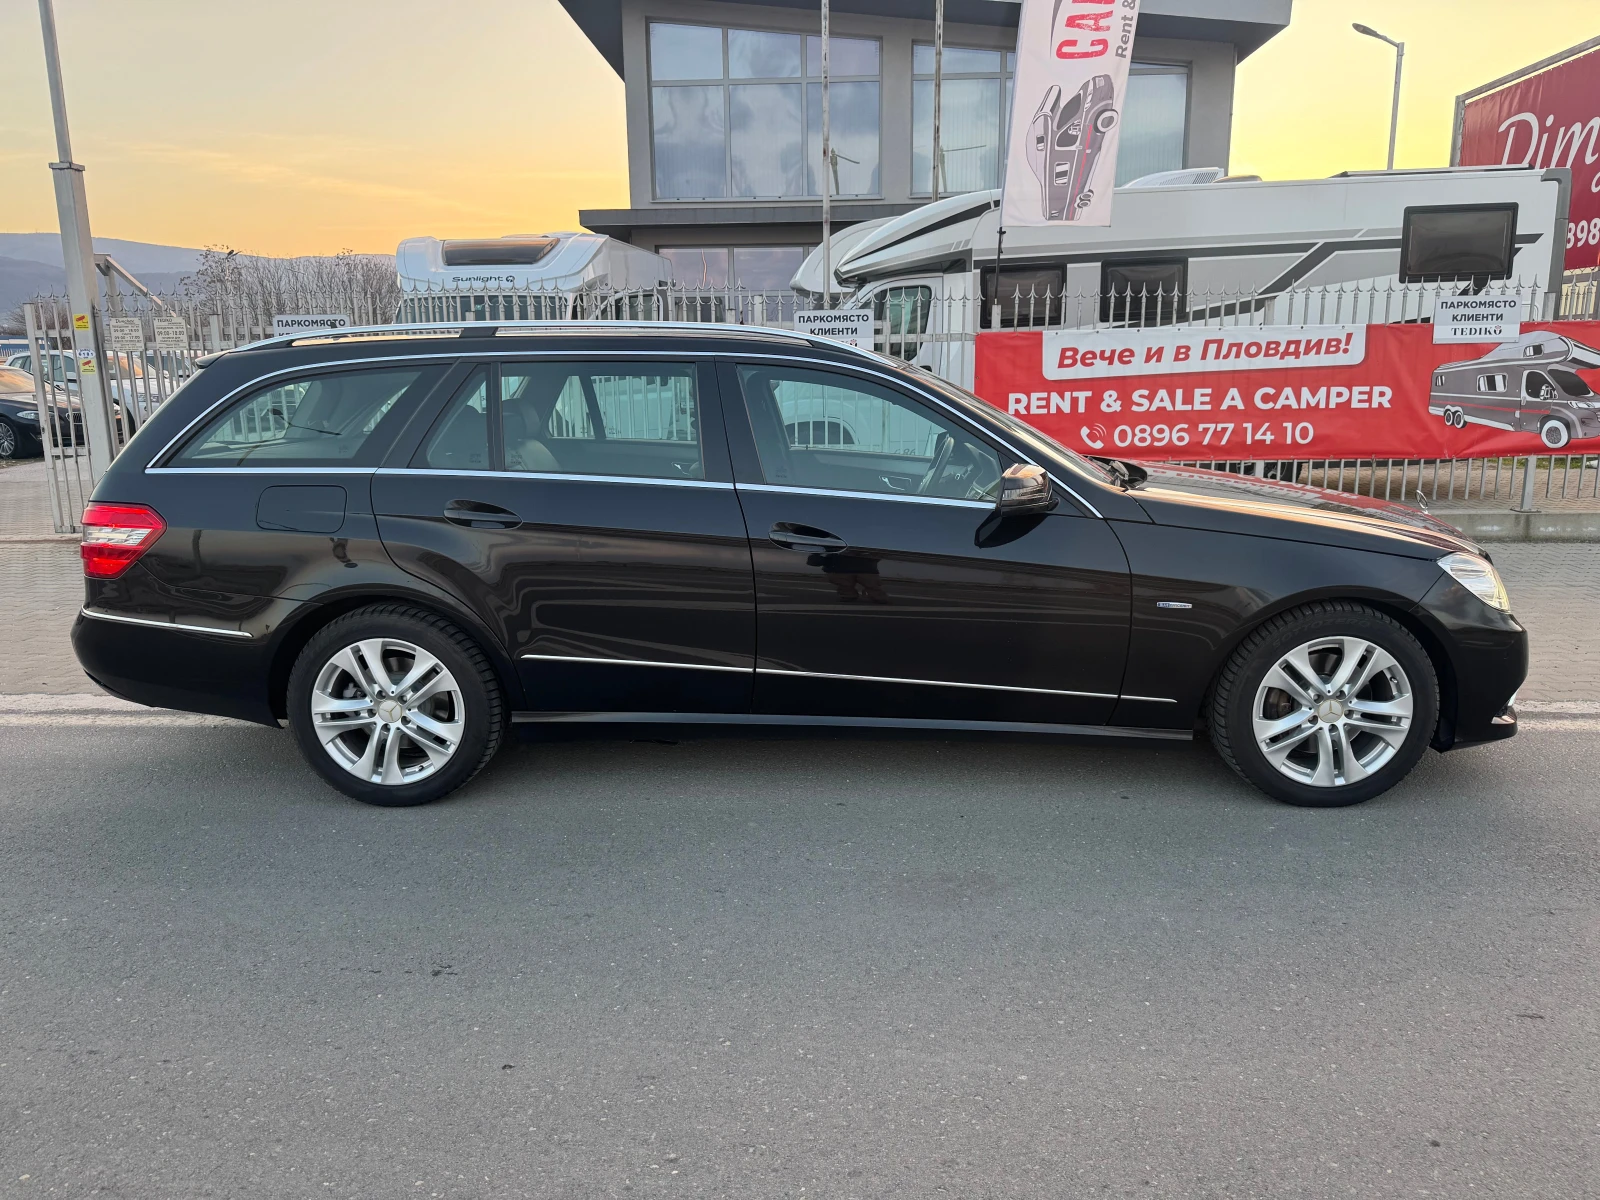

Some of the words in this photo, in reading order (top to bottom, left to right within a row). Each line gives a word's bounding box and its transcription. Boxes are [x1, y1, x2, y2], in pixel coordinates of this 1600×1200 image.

[1056, 0, 1115, 59] CA
[1115, 15, 1134, 58] Rent
[452, 275, 503, 283] Sunlight
[1440, 300, 1517, 309] ПАРКОМЯСТО
[798, 314, 869, 323] ПАРКОМЯСТО
[1451, 313, 1504, 322] КЛИЕНТИ
[810, 327, 858, 335] КЛИЕНТИ
[1057, 347, 1135, 369] Вече
[1144, 346, 1164, 364] и
[1173, 345, 1191, 362] в
[1201, 333, 1353, 361] Пловдив!
[1008, 391, 1092, 414] RENT
[1100, 389, 1122, 413] &
[1131, 388, 1211, 412] SALE
[1220, 387, 1244, 410] A
[1254, 386, 1393, 410] CAMPER
[1113, 424, 1190, 448] 0896
[1198, 423, 1234, 445] 77
[1243, 423, 1275, 445] 14
[1283, 422, 1314, 445] 10
